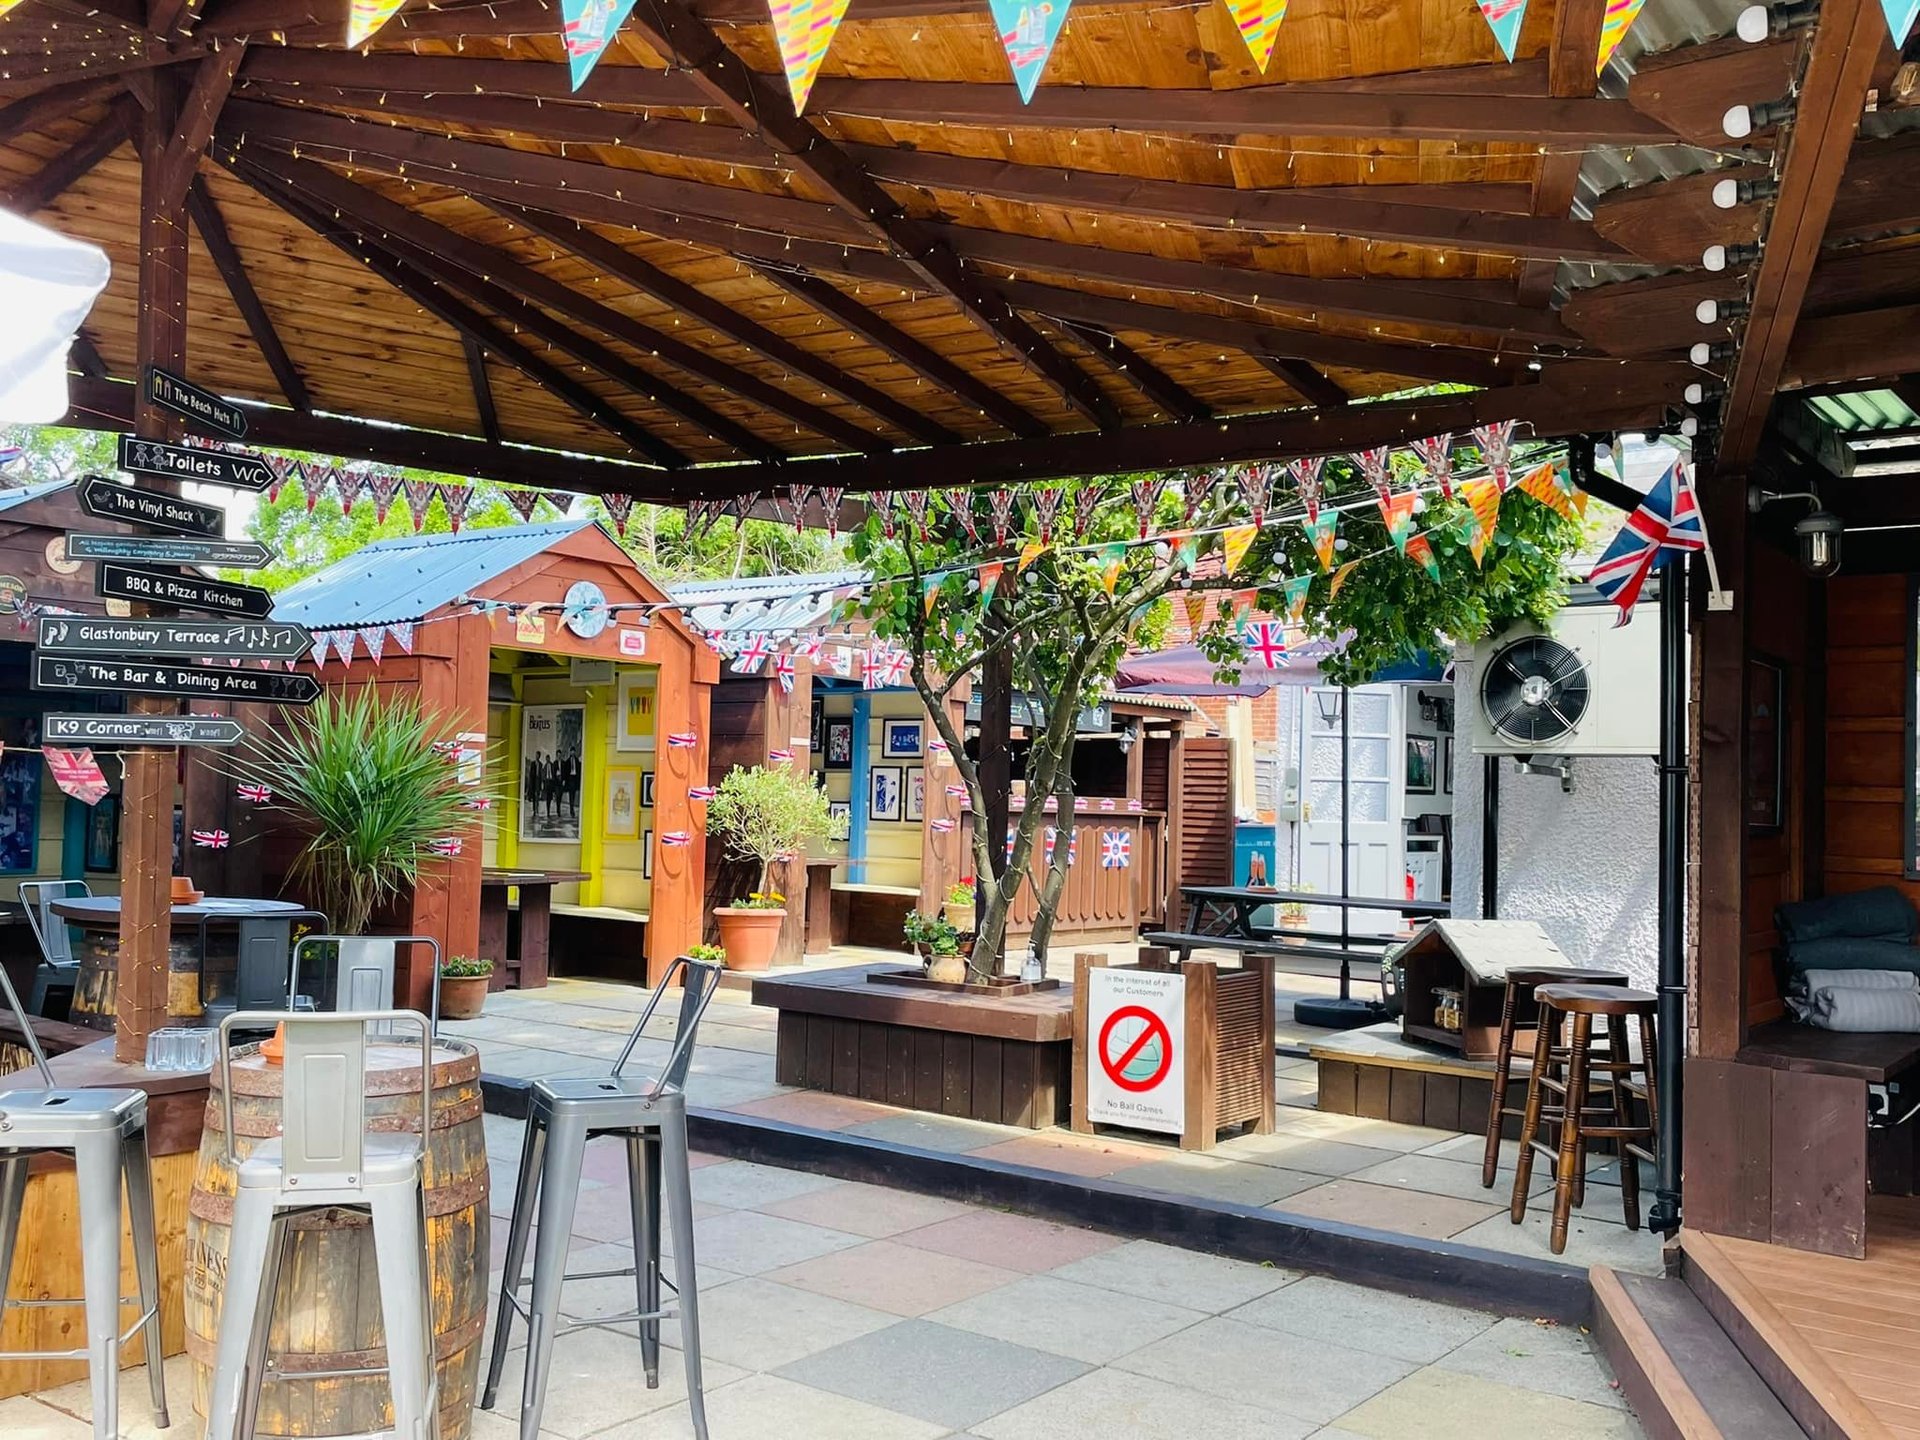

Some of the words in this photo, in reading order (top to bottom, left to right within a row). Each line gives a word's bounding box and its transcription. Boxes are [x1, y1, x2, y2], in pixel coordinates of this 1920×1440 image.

[174, 386, 189, 405] The
[190, 391, 212, 415] Beach
[214, 408, 231, 426] Huts
[166, 451, 221, 476] Toilets
[232, 464, 266, 484] WC
[115, 493, 135, 510] The
[138, 498, 163, 518] Vinyl
[166, 505, 194, 523] Shack
[125, 576, 150, 593] BBQ
[154, 581, 164, 594] &
[167, 583, 197, 600] Pizza
[203, 588, 244, 608] Kitchen
[79, 626, 160, 644] Glastonbury
[167, 630, 220, 644] Terrace
[89, 665, 117, 682] The
[123, 668, 149, 684] Bar
[154, 671, 166, 685] &
[177, 672, 220, 690] Dining
[224, 676, 257, 690] Area
[57, 720, 79, 735] K9
[86, 721, 141, 735] Corner
[1126, 987, 1164, 997] Customers
[1107, 1100, 1118, 1109] No
[1120, 1101, 1135, 1110] Ball
[1136, 1103, 1164, 1114] Games
